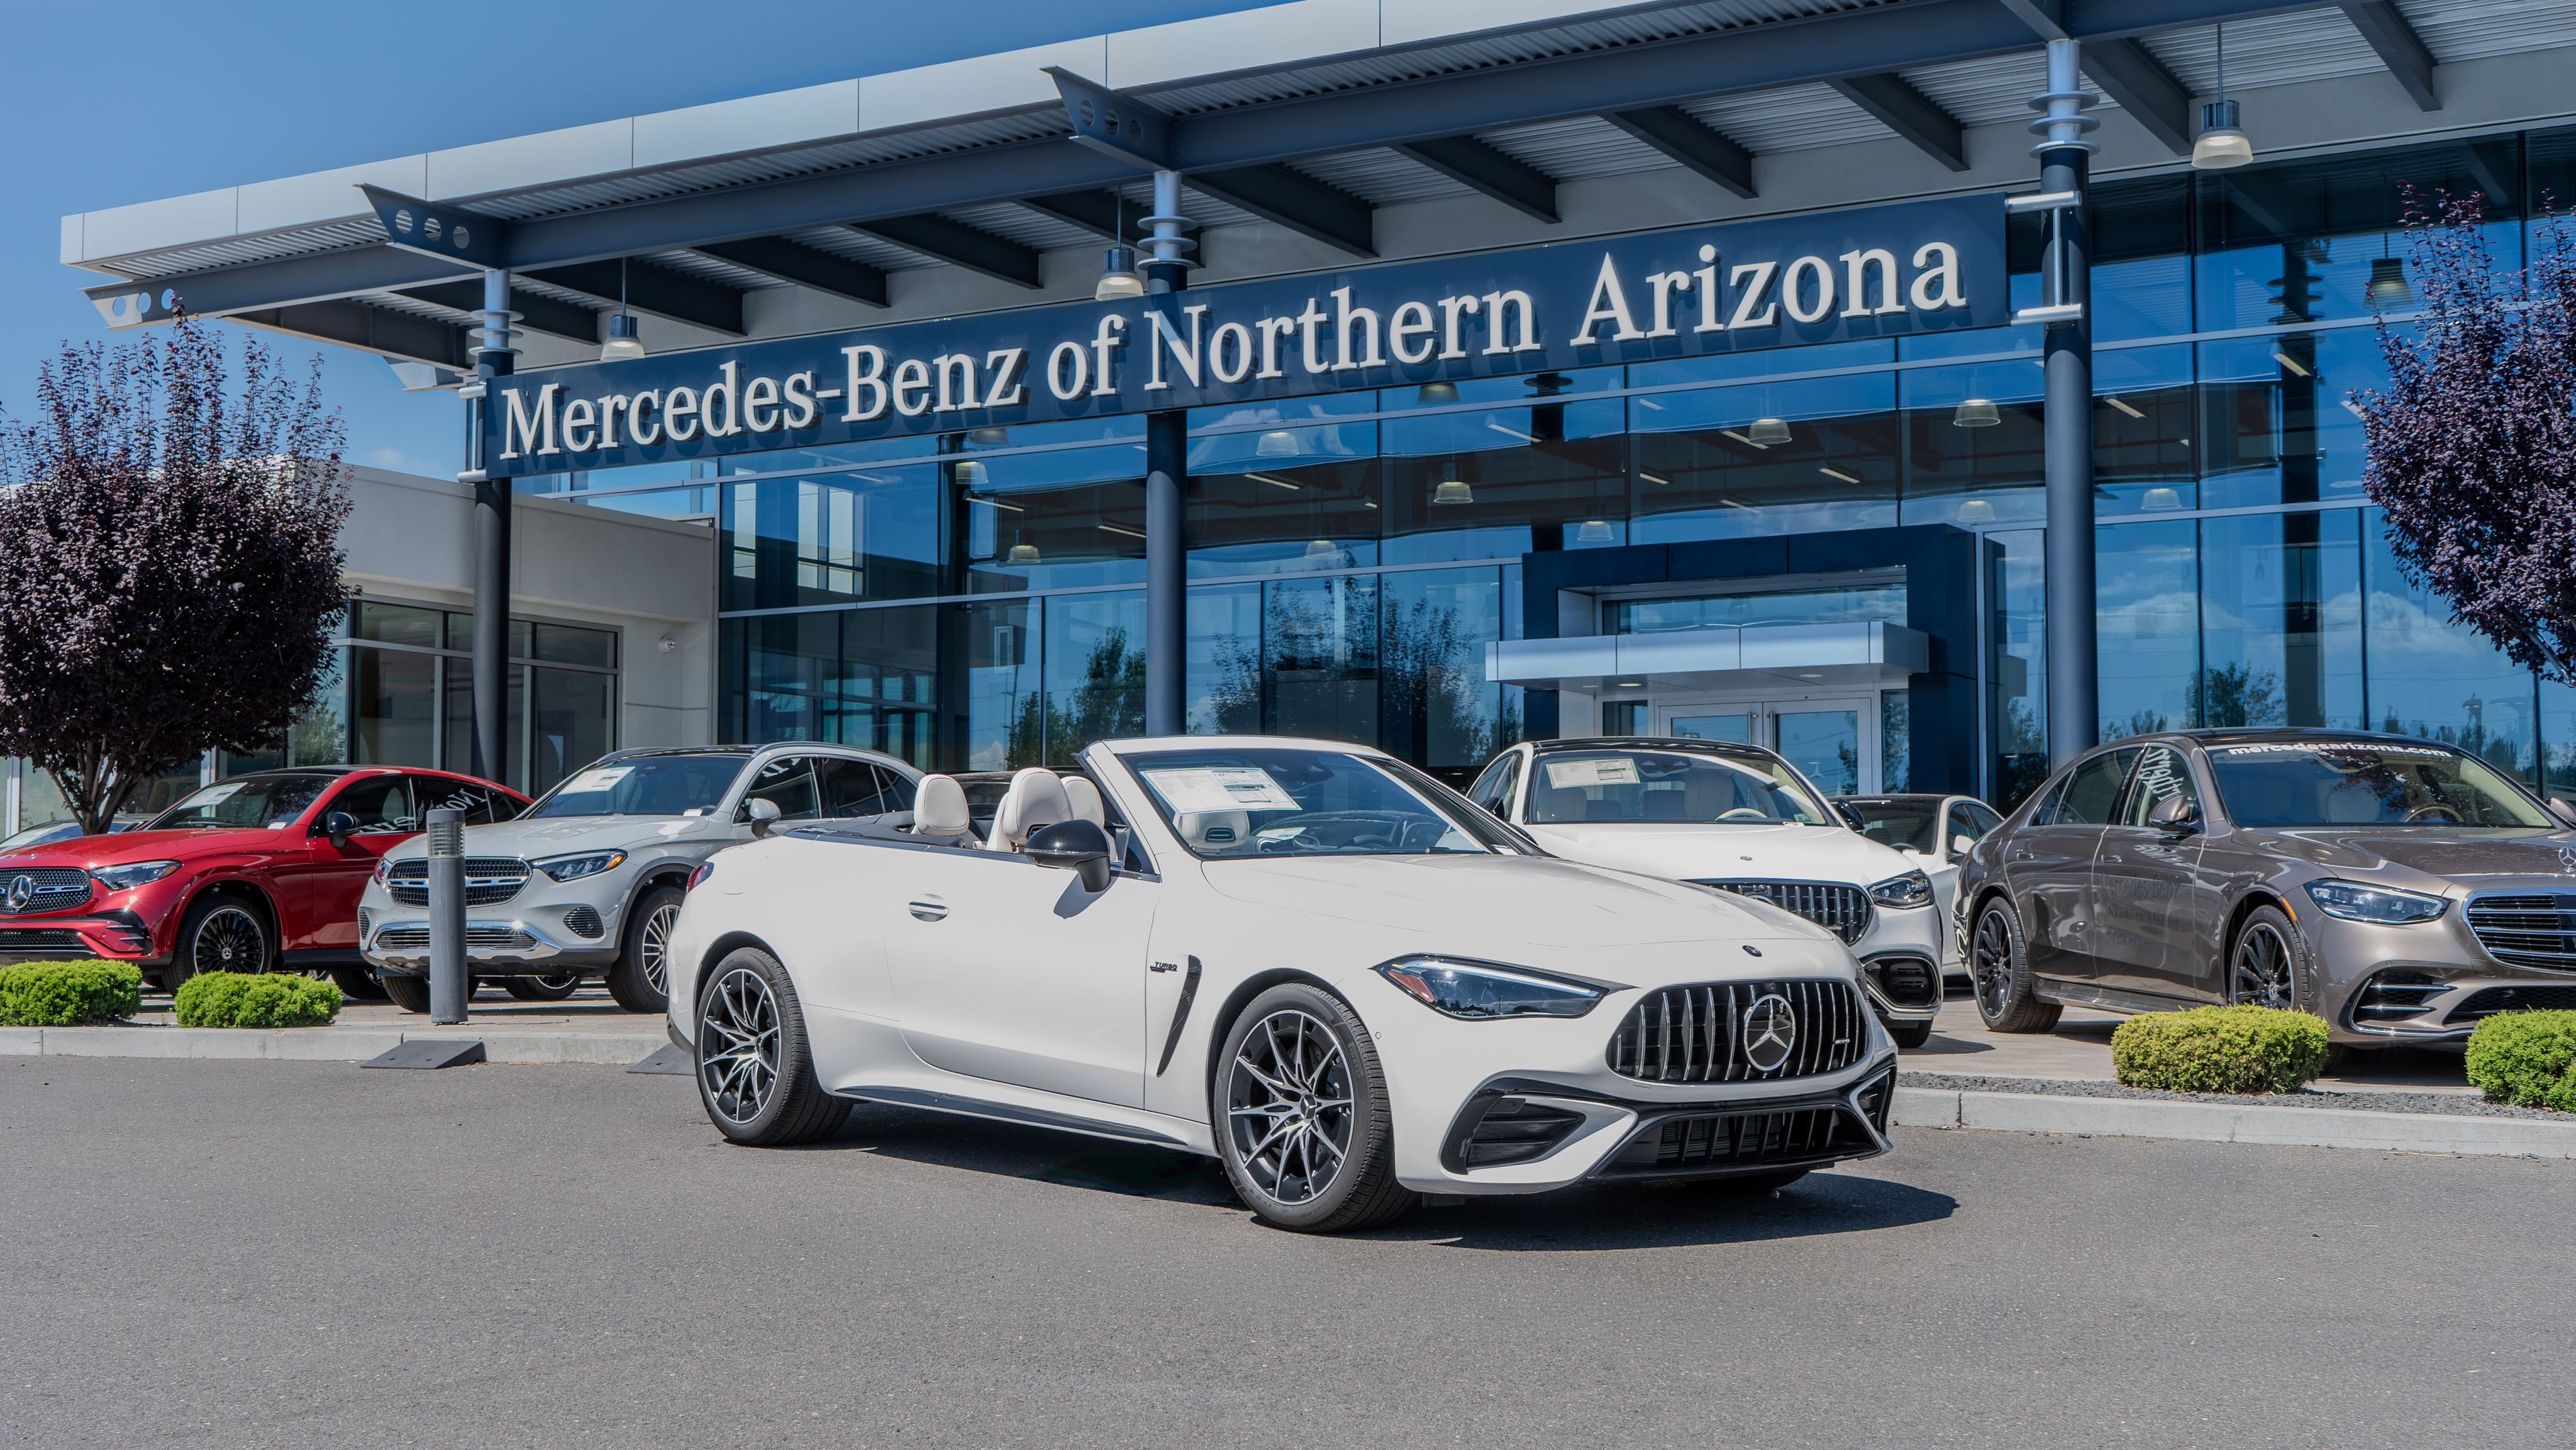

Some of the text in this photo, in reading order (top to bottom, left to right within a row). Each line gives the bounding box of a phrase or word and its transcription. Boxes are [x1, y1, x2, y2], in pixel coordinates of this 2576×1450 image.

[500, 243, 1967, 460] Mercedes-Benz of Northern Arizona
[2227, 742, 2453, 758] mercedesarizona.com
